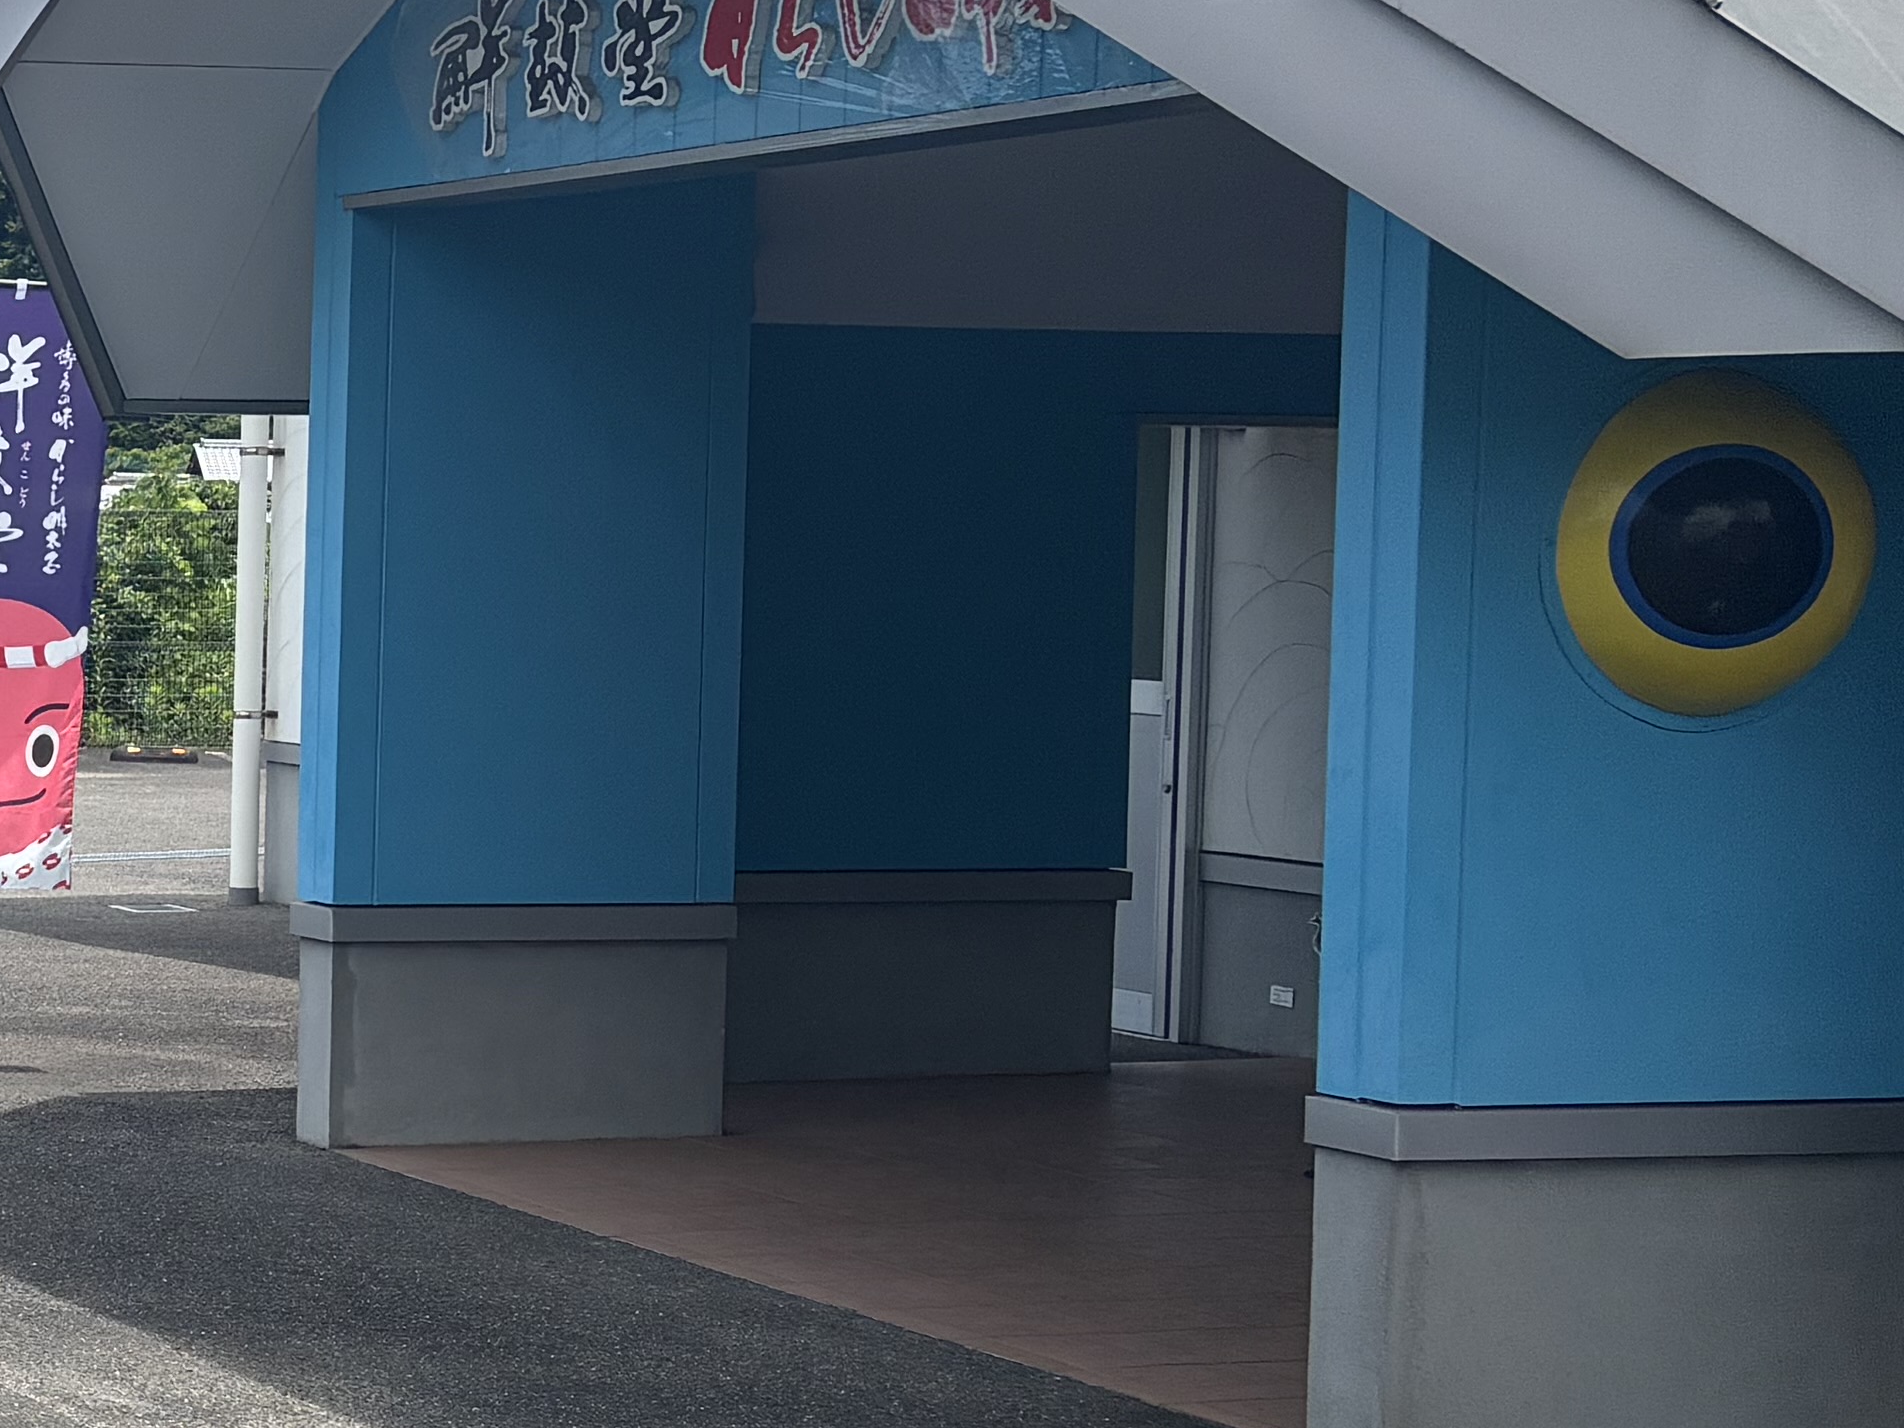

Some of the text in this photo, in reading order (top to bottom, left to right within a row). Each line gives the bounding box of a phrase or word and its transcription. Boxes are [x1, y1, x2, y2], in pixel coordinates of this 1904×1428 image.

[19, 441, 32, 508] せんこどう
[42, 339, 77, 574] 博多の味 からし明太子
